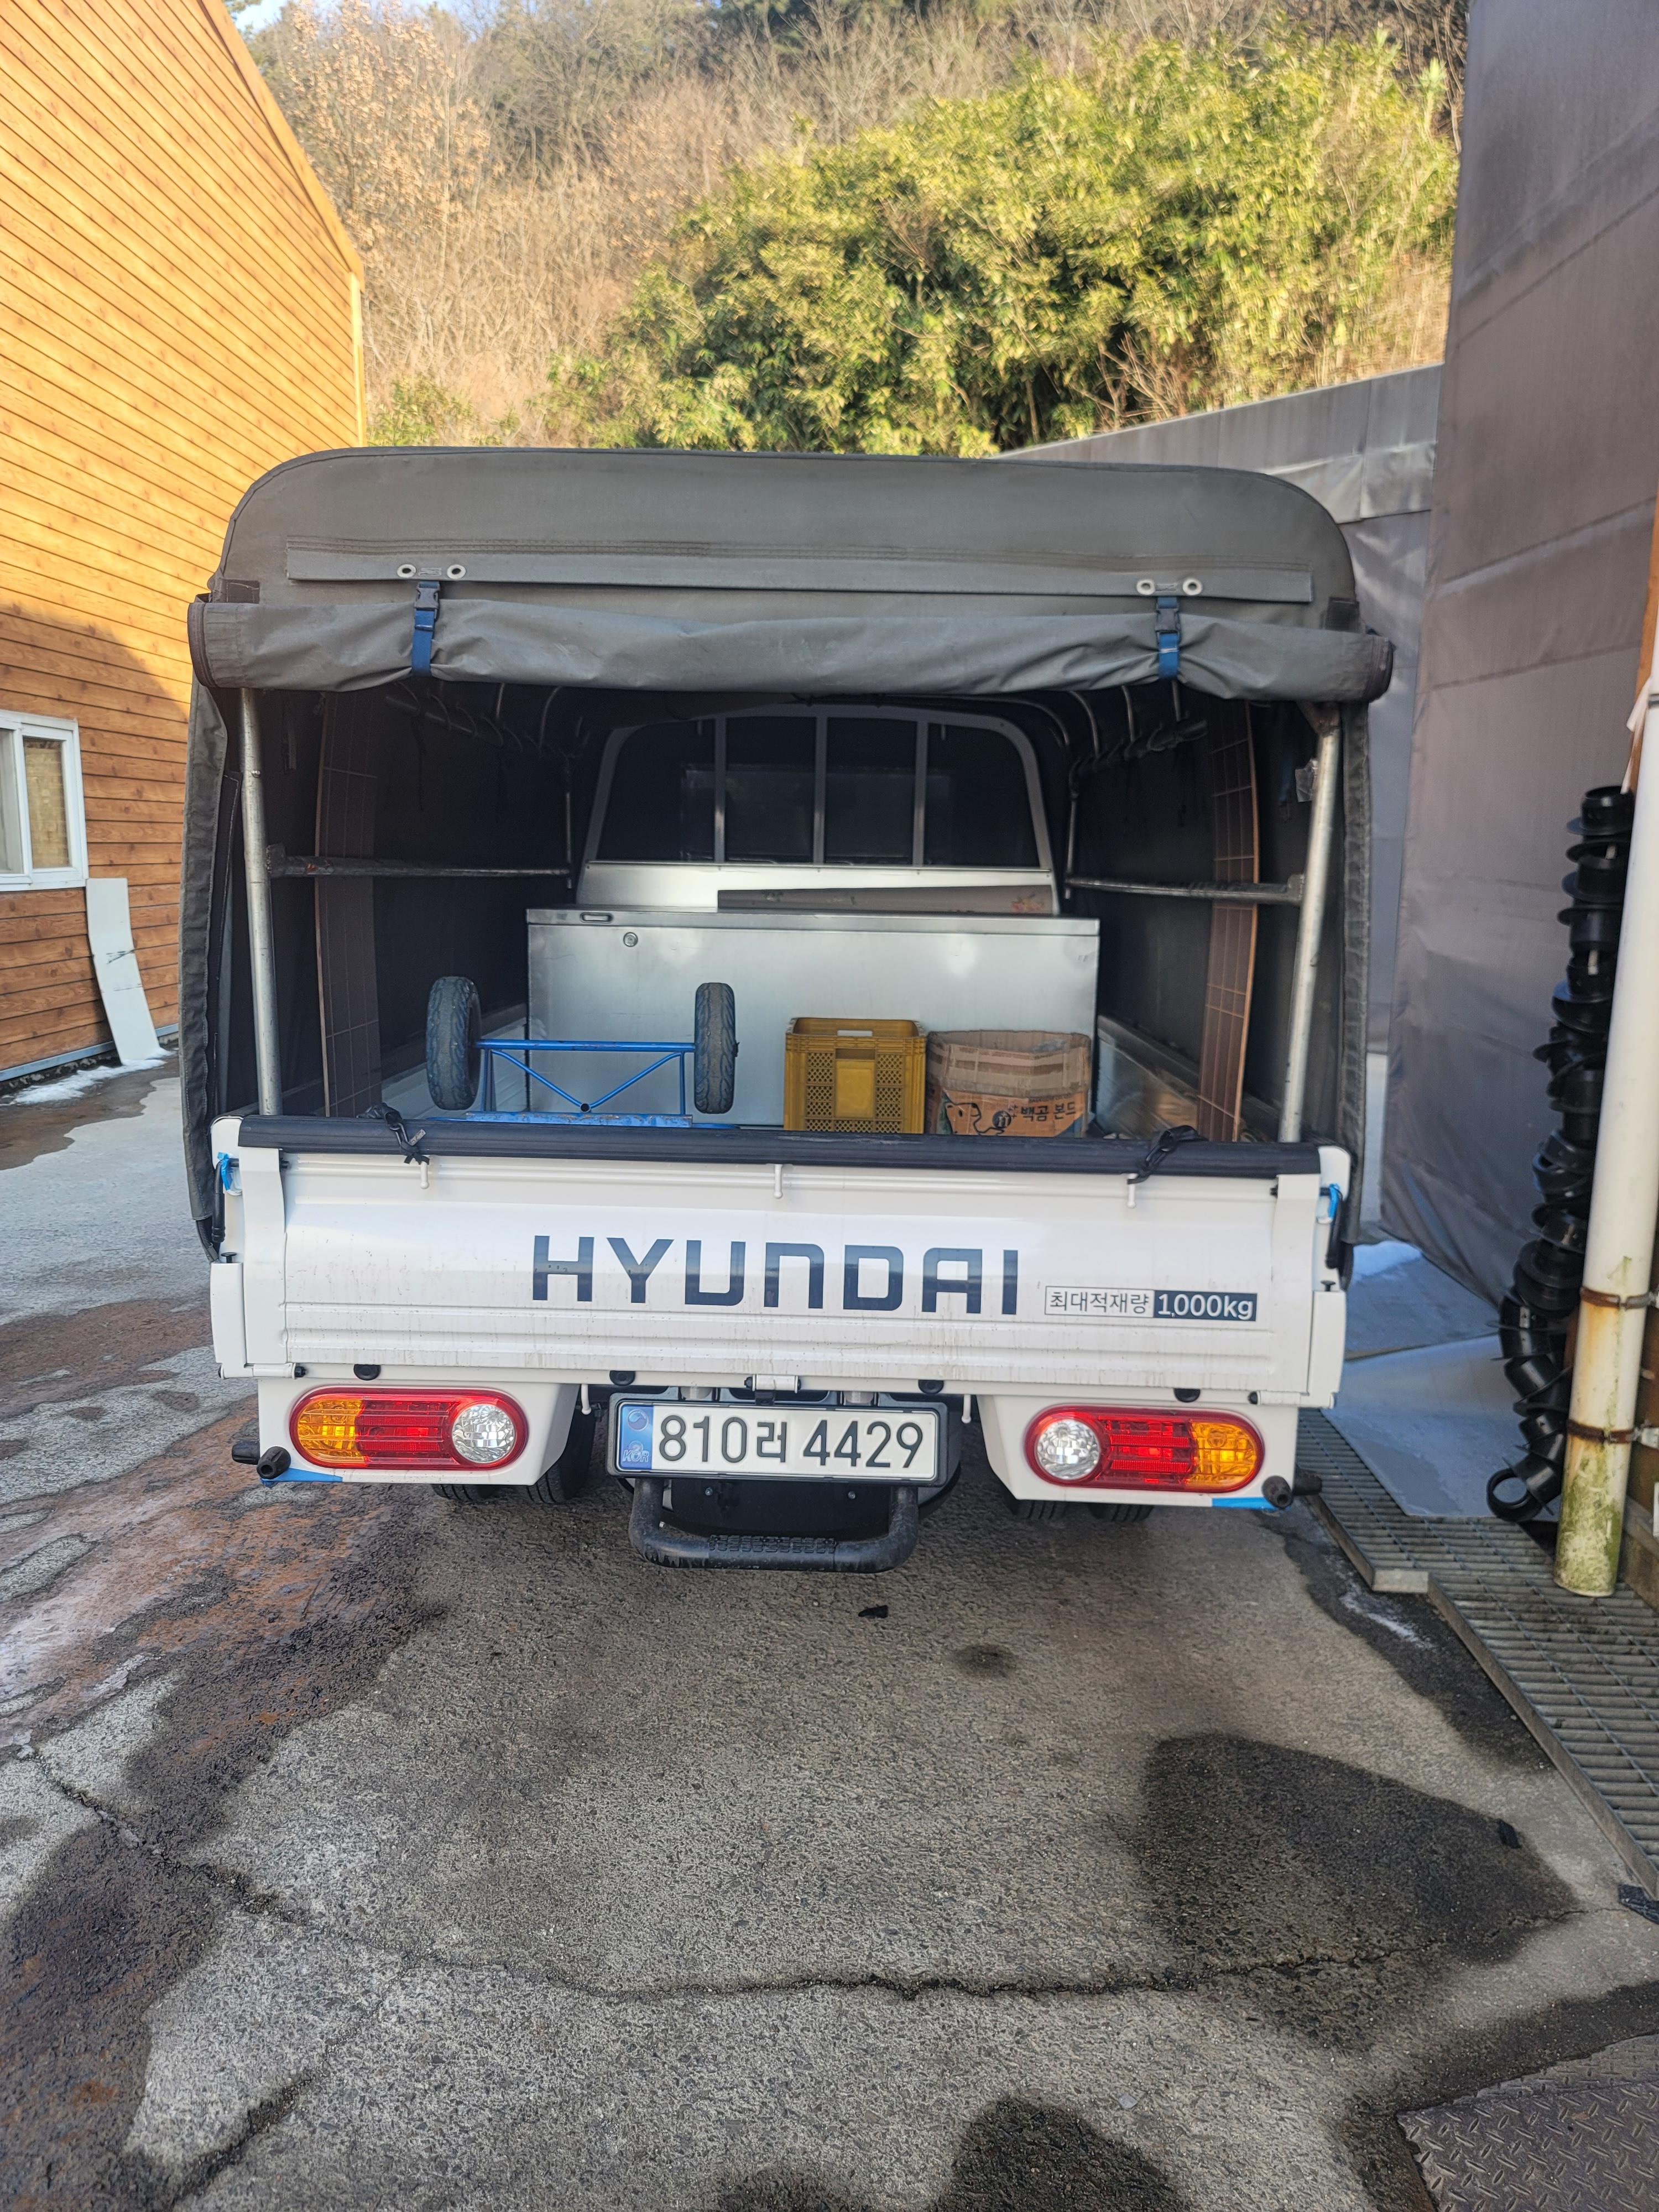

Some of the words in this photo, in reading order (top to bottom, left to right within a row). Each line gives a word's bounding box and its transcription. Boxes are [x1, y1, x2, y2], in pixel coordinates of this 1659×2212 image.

[1021, 1105, 1048, 1121] 백곰
[1053, 1102, 1076, 1119] 본드
[533, 1235, 1018, 1315] HYUNDAI
[1050, 1290, 1149, 1314] 최대적재량
[1157, 1293, 1254, 1320] 1,000kg
[623, 1449, 649, 1463] KOR
[659, 1415, 787, 1463] 810러
[802, 1419, 923, 1468] 4429
